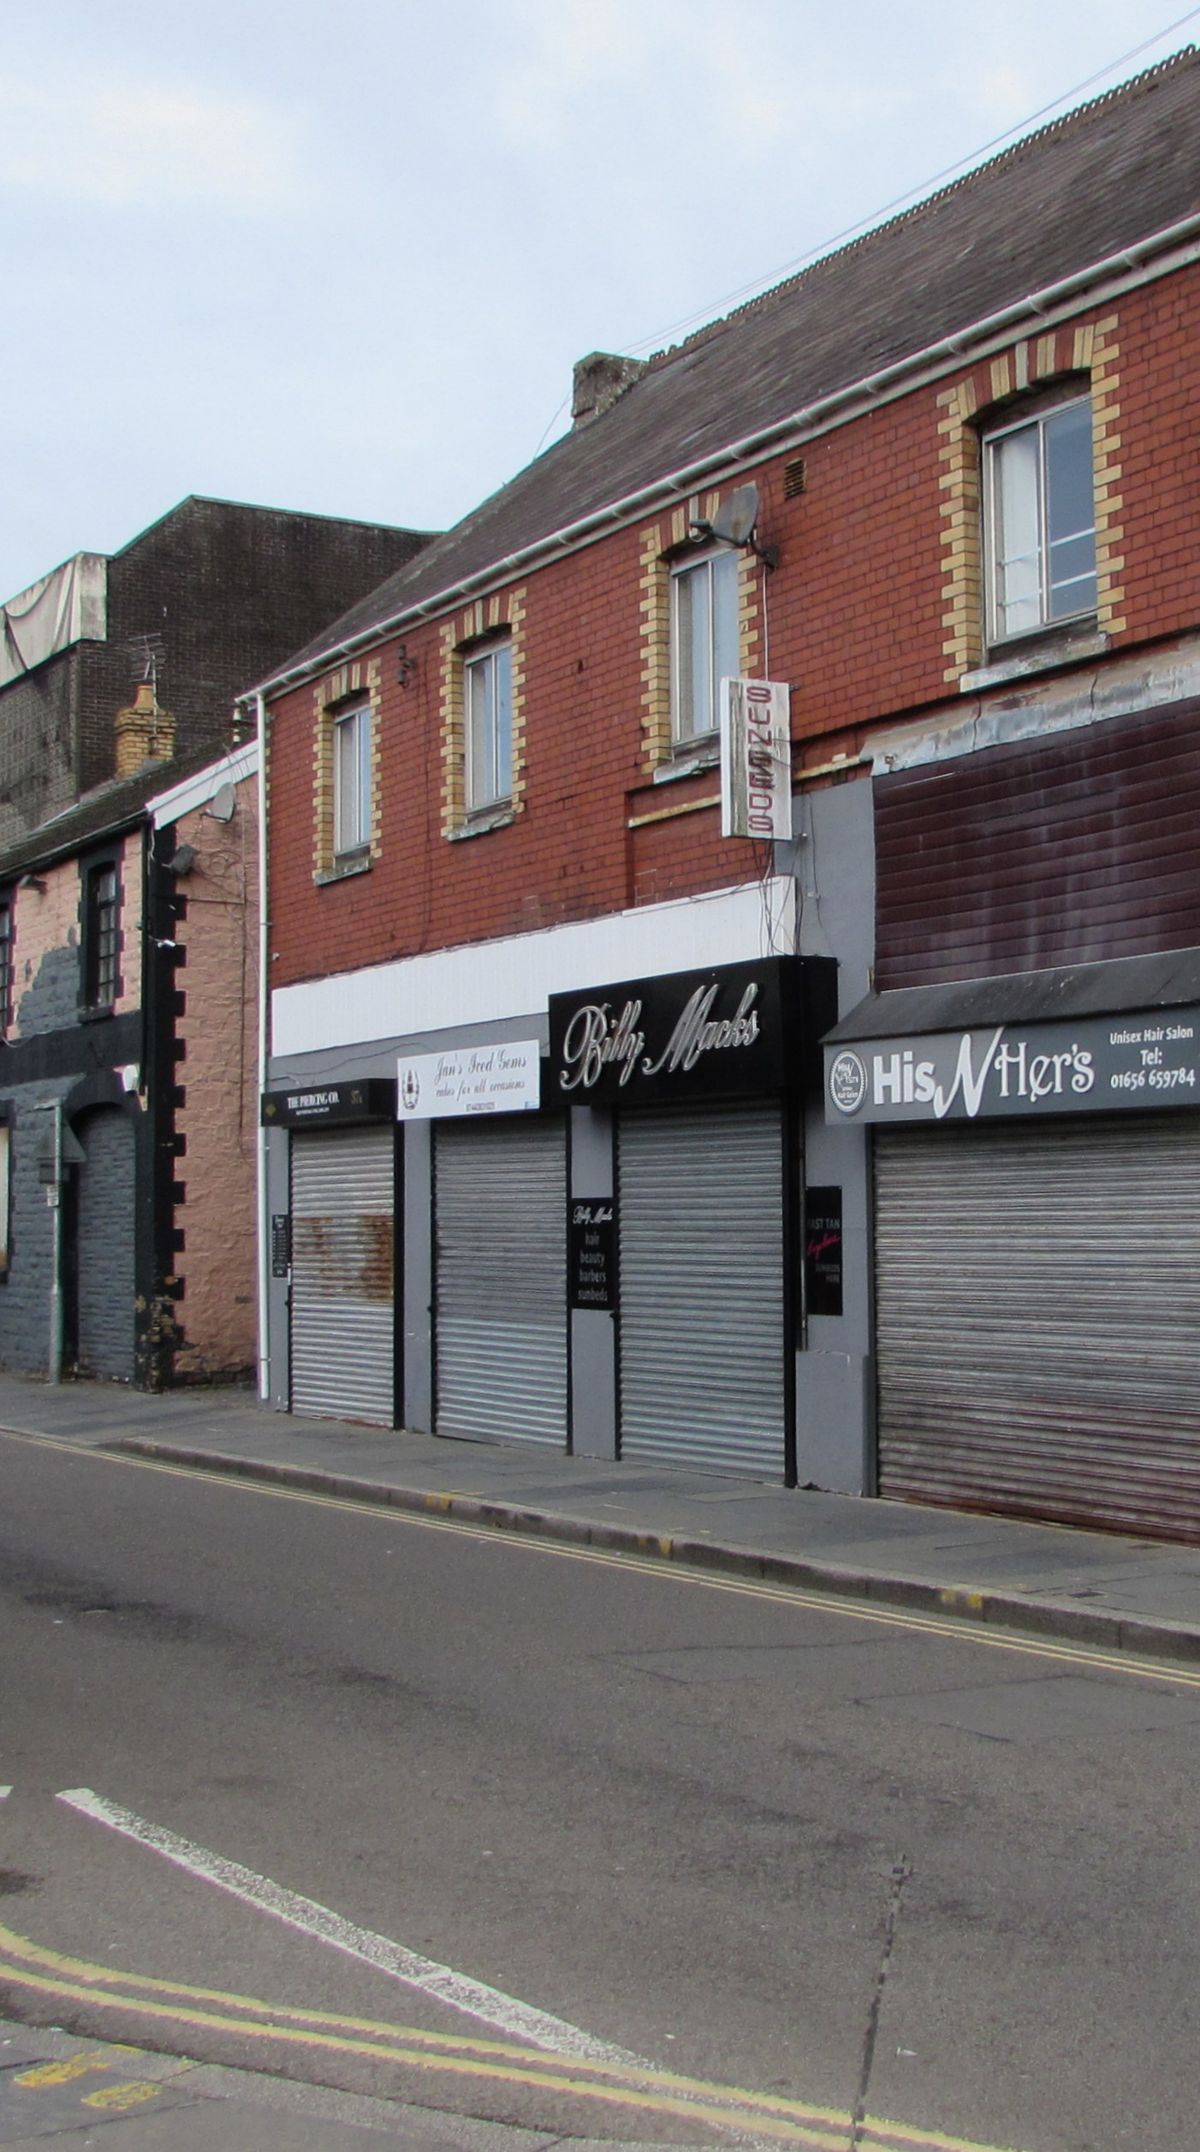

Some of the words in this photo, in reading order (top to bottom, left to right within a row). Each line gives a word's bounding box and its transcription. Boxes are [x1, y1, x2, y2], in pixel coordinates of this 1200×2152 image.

[559, 1000, 645, 1090] Billy
[642, 982, 760, 1075] Macks
[1109, 1030, 1142, 1045] Unisex
[1143, 1027, 1165, 1042] Hair
[1166, 1025, 1194, 1040] Salon
[433, 1053, 463, 1085] Jan's
[467, 1051, 495, 1074] Iced
[497, 1048, 527, 1070] Gems
[1140, 1047, 1163, 1066] Tel:
[873, 1051, 936, 1105] His
[933, 1026, 1005, 1118] N
[1110, 1070, 1146, 1091] 01656
[1148, 1067, 1196, 1089] 659784
[457, 1080, 470, 1102] for
[474, 1078, 487, 1093] all
[489, 1078, 525, 1092] occasions
[287, 1097, 299, 1109] THE
[585, 1231, 600, 1246] hair
[580, 1249, 605, 1267] beauty
[579, 1267, 606, 1283] barbers
